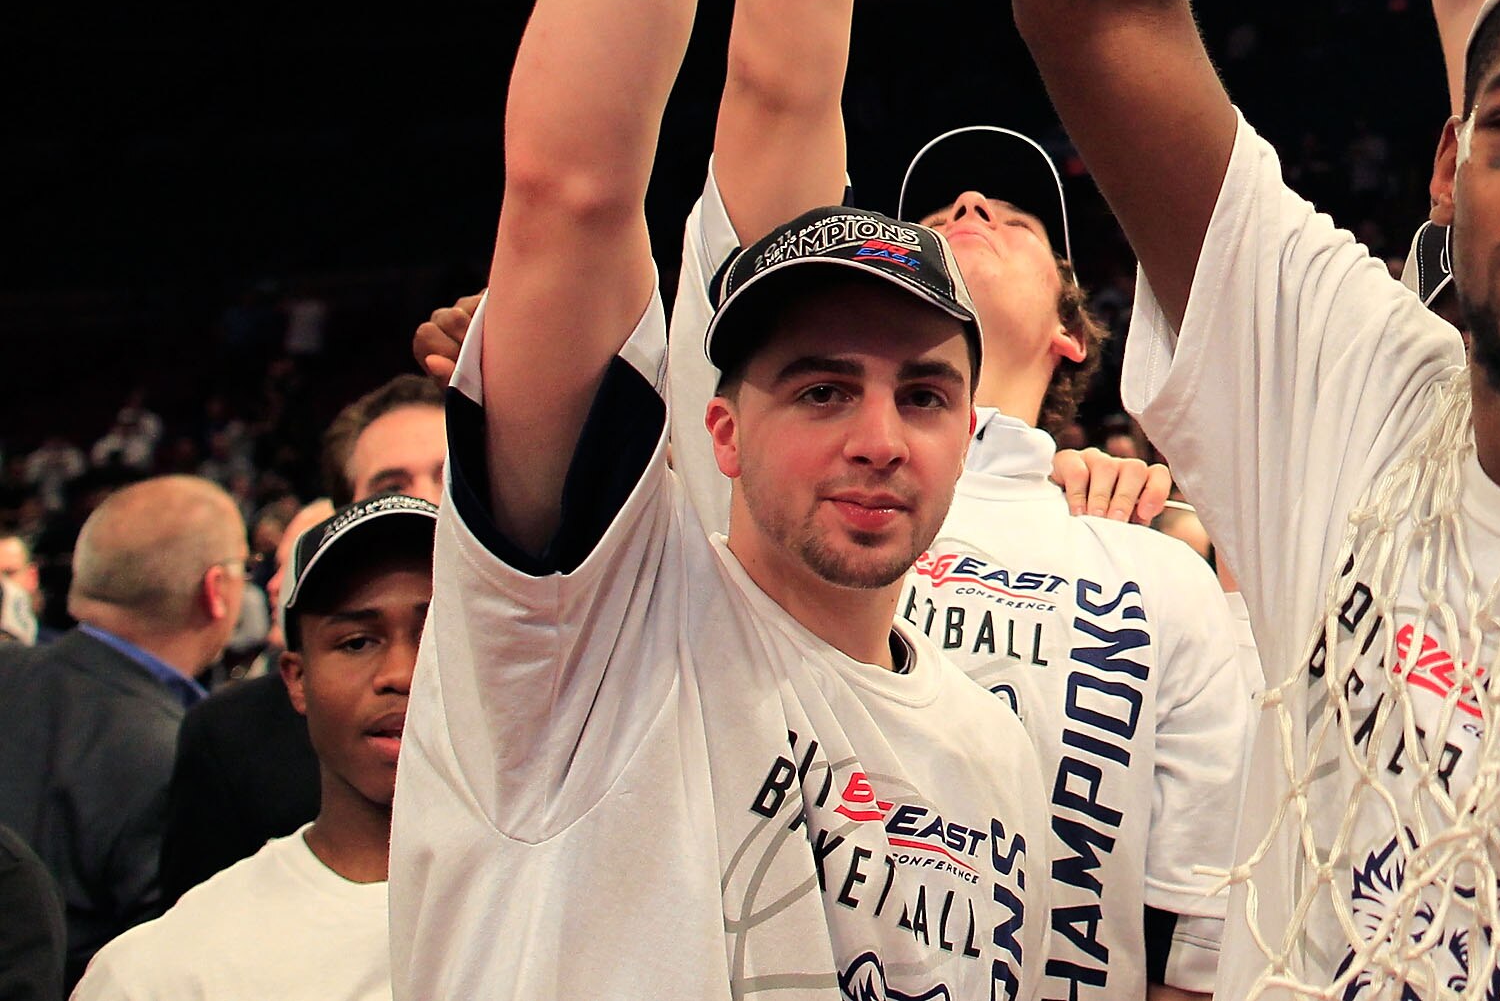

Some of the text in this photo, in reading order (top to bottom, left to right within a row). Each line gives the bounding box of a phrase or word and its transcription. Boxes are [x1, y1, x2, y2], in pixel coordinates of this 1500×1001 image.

[799, 214, 879, 238] BASKETBALL
[854, 247, 921, 269] EAST
[952, 556, 1070, 593] EAST
[955, 586, 1057, 612] CONFERENCE
[885, 804, 988, 856] EAST
